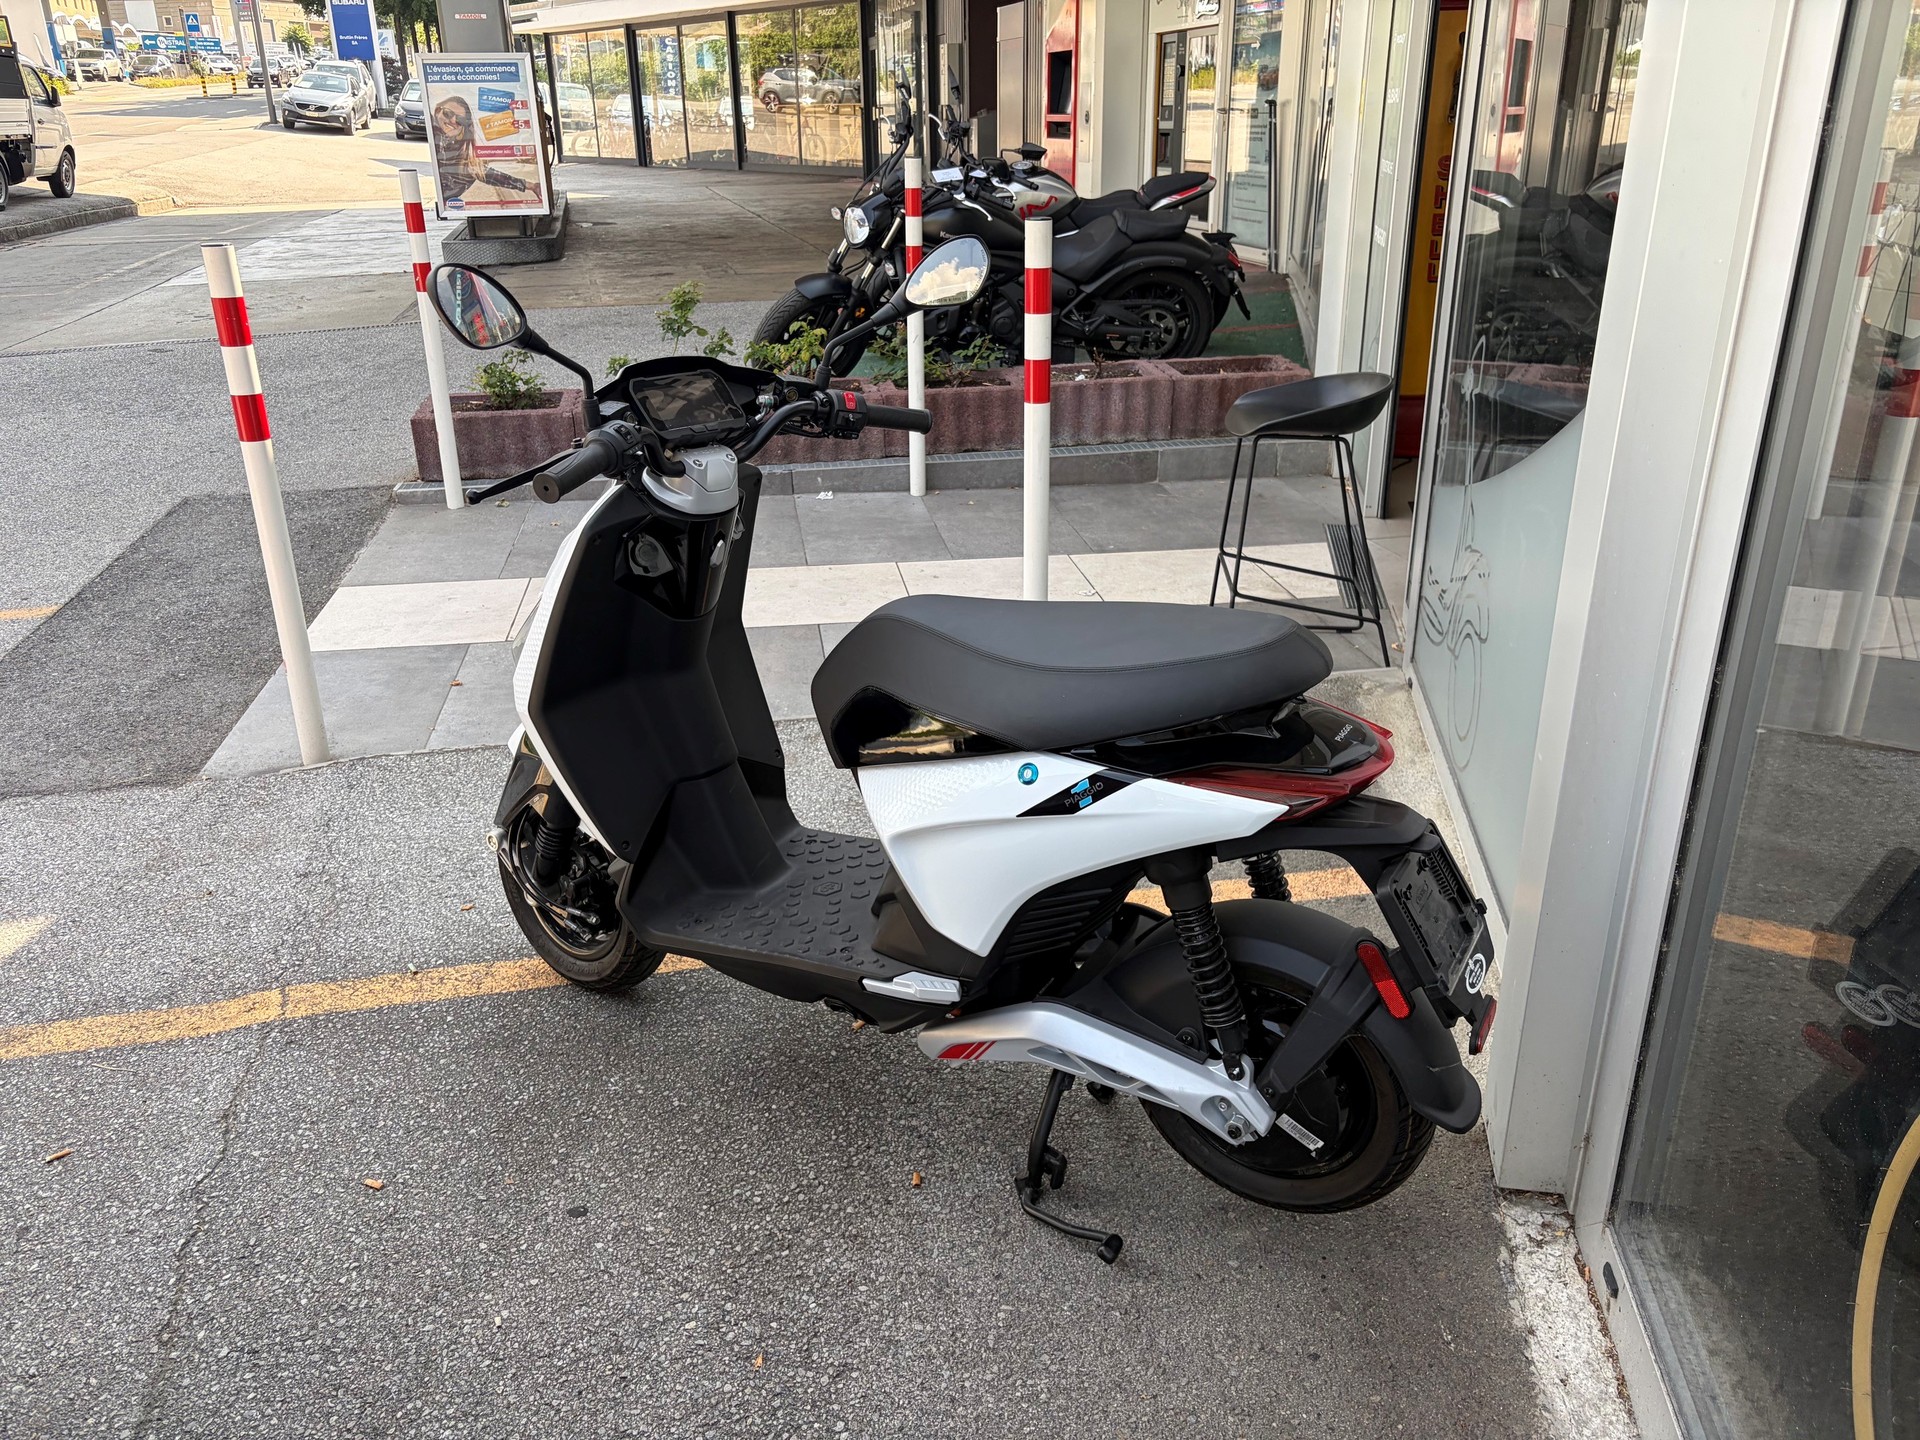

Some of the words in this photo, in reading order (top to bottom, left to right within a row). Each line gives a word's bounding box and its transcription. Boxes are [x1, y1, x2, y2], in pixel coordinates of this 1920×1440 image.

[426, 65, 464, 73] L'évasion,
[464, 65, 474, 74] ça
[475, 65, 516, 73] commence
[428, 74, 441, 82] par
[442, 73, 456, 81] des
[457, 72, 500, 81] économies!
[1064, 781, 1104, 808] PIAGGIO
